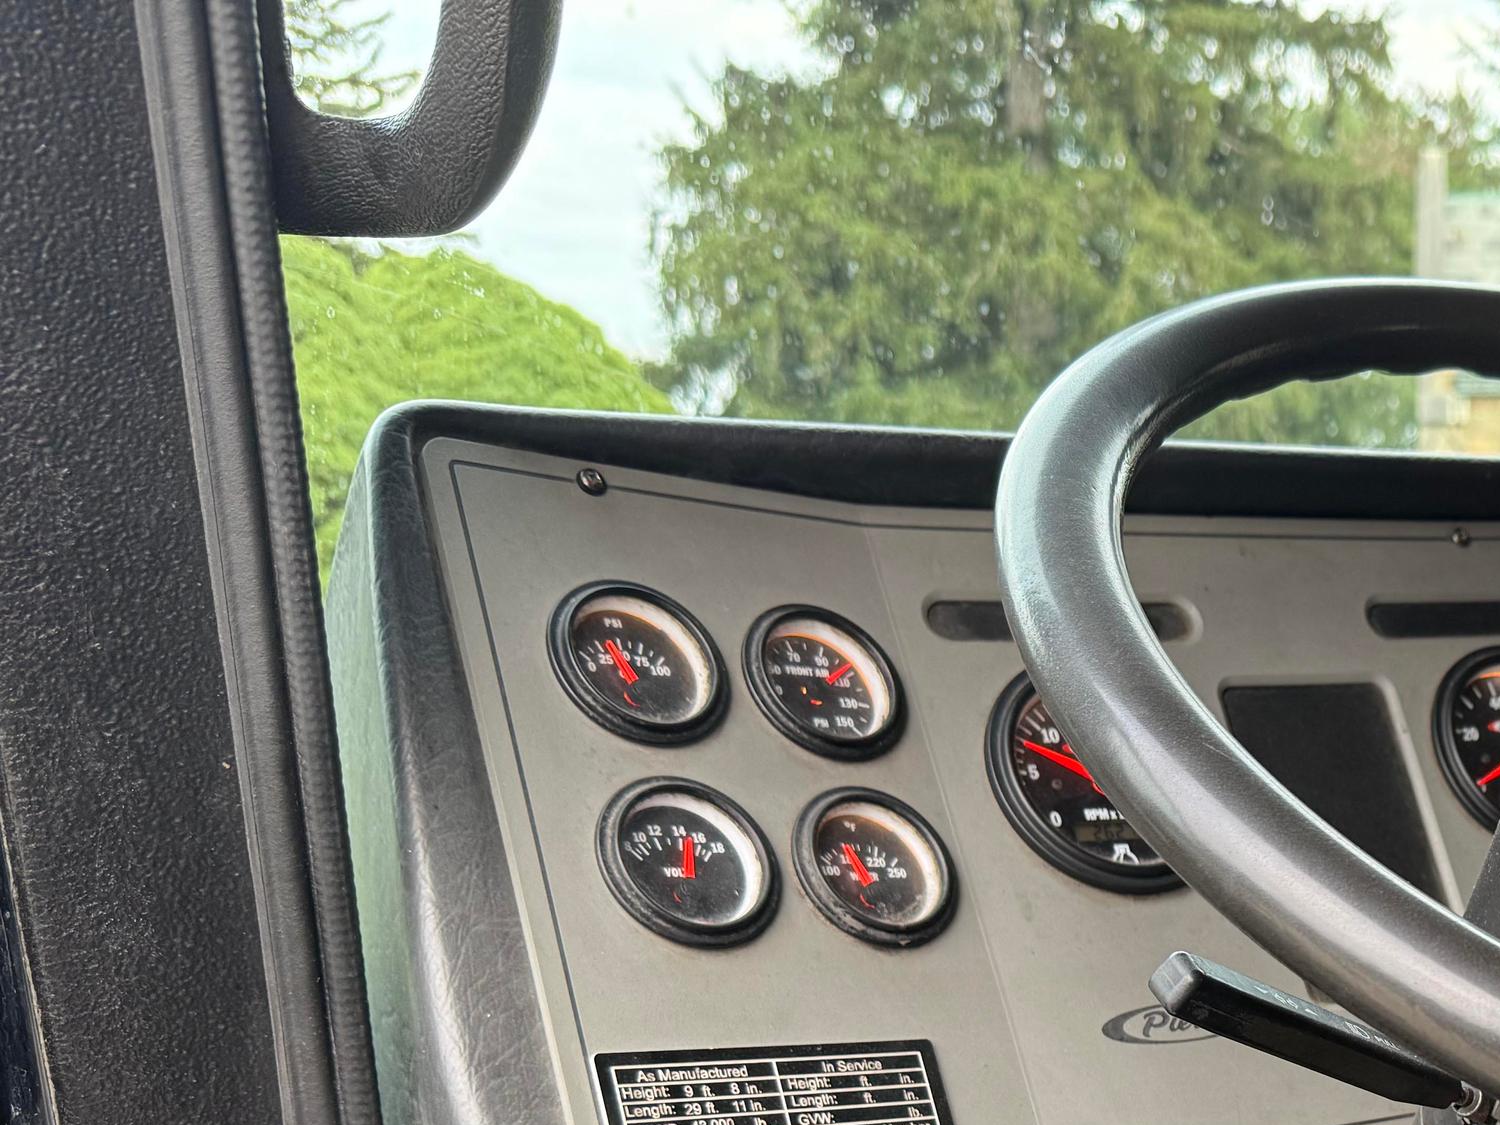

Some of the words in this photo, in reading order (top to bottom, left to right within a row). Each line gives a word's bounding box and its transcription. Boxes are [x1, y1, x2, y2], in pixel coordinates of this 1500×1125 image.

[604, 618, 623, 629] PSI
[598, 654, 614, 665] 25
[634, 656, 650, 668] 75
[787, 652, 801, 662] 70
[815, 656, 829, 667] 90
[588, 662, 597, 672] 0
[650, 666, 671, 677] 100
[785, 666, 814, 677] FRONT
[840, 698, 858, 709] 130
[813, 717, 829, 728] PSI
[835, 716, 854, 728] 150
[1040, 728, 1060, 744] 10
[1027, 764, 1040, 781] 5
[1050, 811, 1062, 827] 0
[1084, 808, 1110, 821] RPM
[647, 825, 662, 836] 12
[672, 826, 686, 837] 14
[632, 832, 646, 843] 10
[691, 833, 707, 844] 16
[710, 843, 725, 854] 18
[866, 858, 886, 868] 220
[822, 866, 840, 876] 100
[887, 868, 907, 879] 250
[823, 1062, 834, 1072] In
[837, 1059, 882, 1072] Service
[638, 1072, 655, 1083] As
[658, 1065, 748, 1082] Manufactured
[787, 1077, 831, 1091] Height:
[860, 1075, 872, 1087] ft.
[899, 1073, 915, 1084] in.
[621, 1086, 671, 1100] Height:
[685, 1086, 693, 1097] 9
[702, 1085, 716, 1097] ft.
[730, 1083, 740, 1095] 8
[746, 1083, 762, 1094] in.
[790, 1095, 839, 1108] Length:
[864, 1093, 877, 1104] ft.
[904, 1090, 919, 1101] in.
[624, 1104, 677, 1119] Length:
[685, 1104, 702, 1116] 29
[706, 1102, 719, 1114] ft.
[732, 1101, 747, 1112] 11
[751, 1100, 766, 1111] in.
[798, 1113, 836, 1125] GVW:
[908, 1107, 923, 1118] lb.
